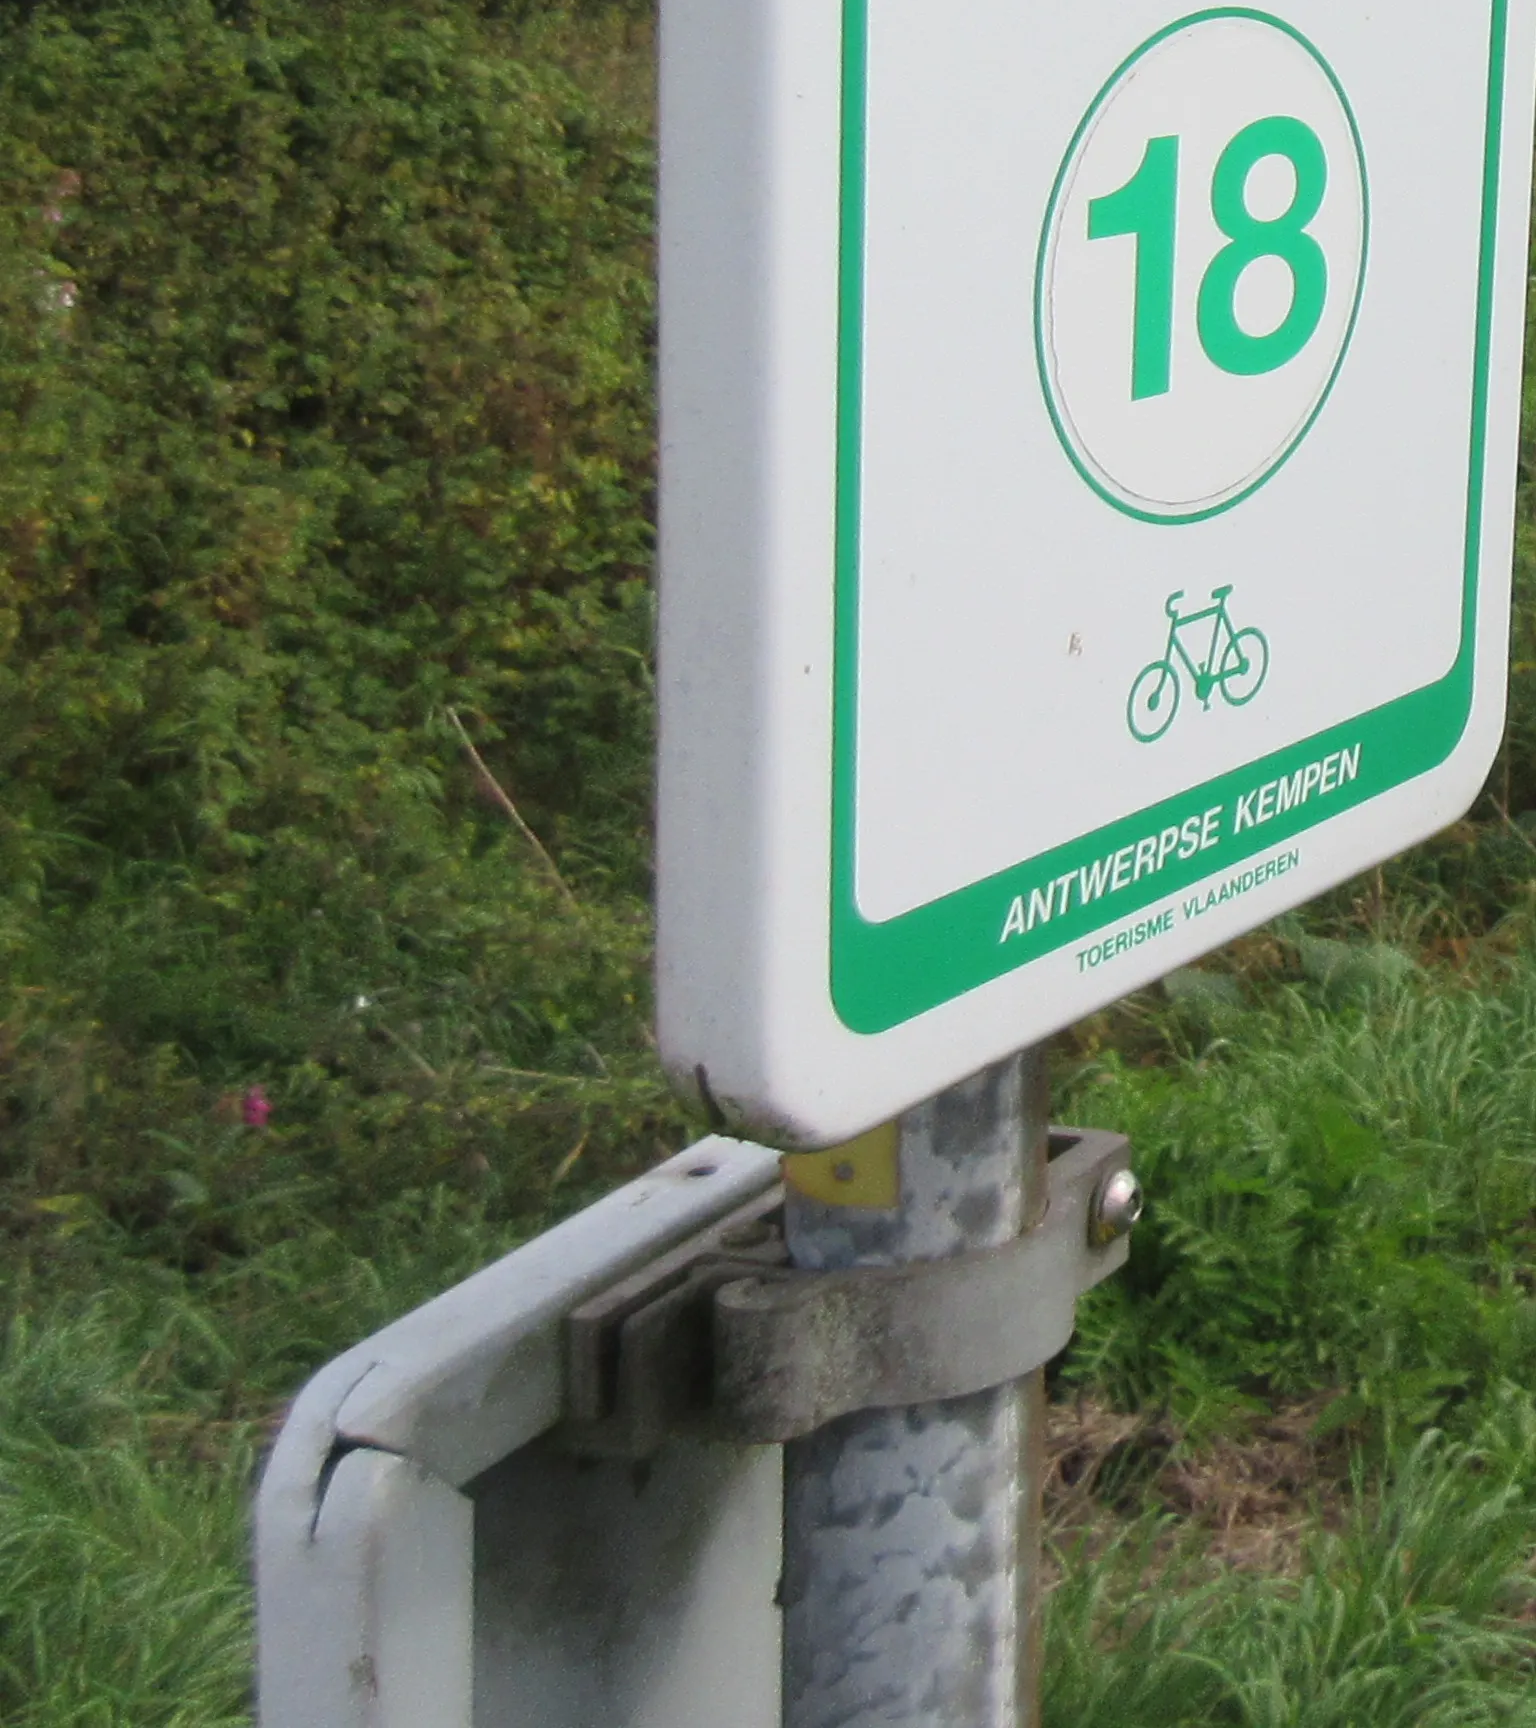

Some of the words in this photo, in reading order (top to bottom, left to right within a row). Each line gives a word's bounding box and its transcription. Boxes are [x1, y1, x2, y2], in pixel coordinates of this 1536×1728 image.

[1087, 115, 1327, 401] 18
[999, 804, 1224, 943] ANTWERPSE
[1232, 743, 1362, 835] KEMPEN
[1076, 908, 1175, 973] TOERISME
[1182, 847, 1300, 921] VLAANDEREN
